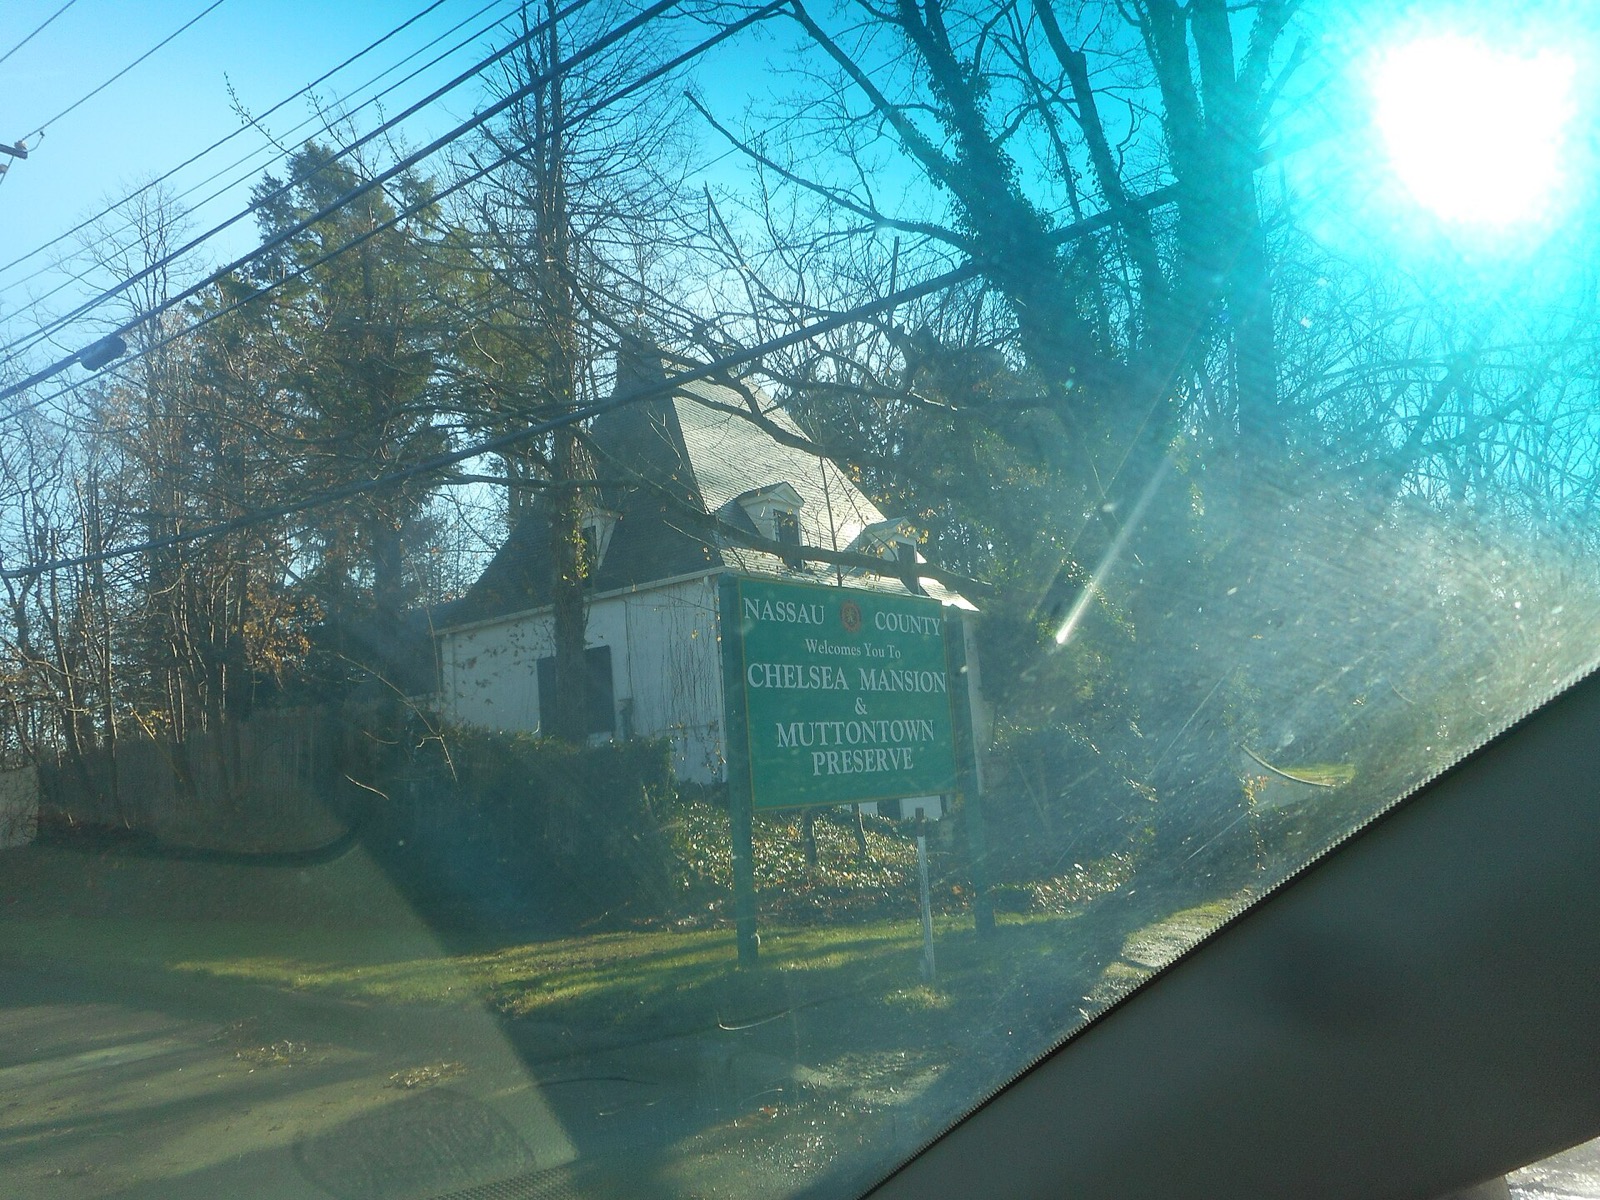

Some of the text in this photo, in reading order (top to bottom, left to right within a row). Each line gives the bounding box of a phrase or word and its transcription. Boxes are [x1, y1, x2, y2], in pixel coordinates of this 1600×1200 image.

[743, 597, 941, 637] NASSAU COUNTY
[805, 638, 901, 659] Welcomes You To
[747, 663, 947, 693] CHELSEA MANSION
[854, 697, 868, 715] &
[775, 719, 935, 748] MUTTONTOWN
[811, 747, 914, 776] PRESERVE
